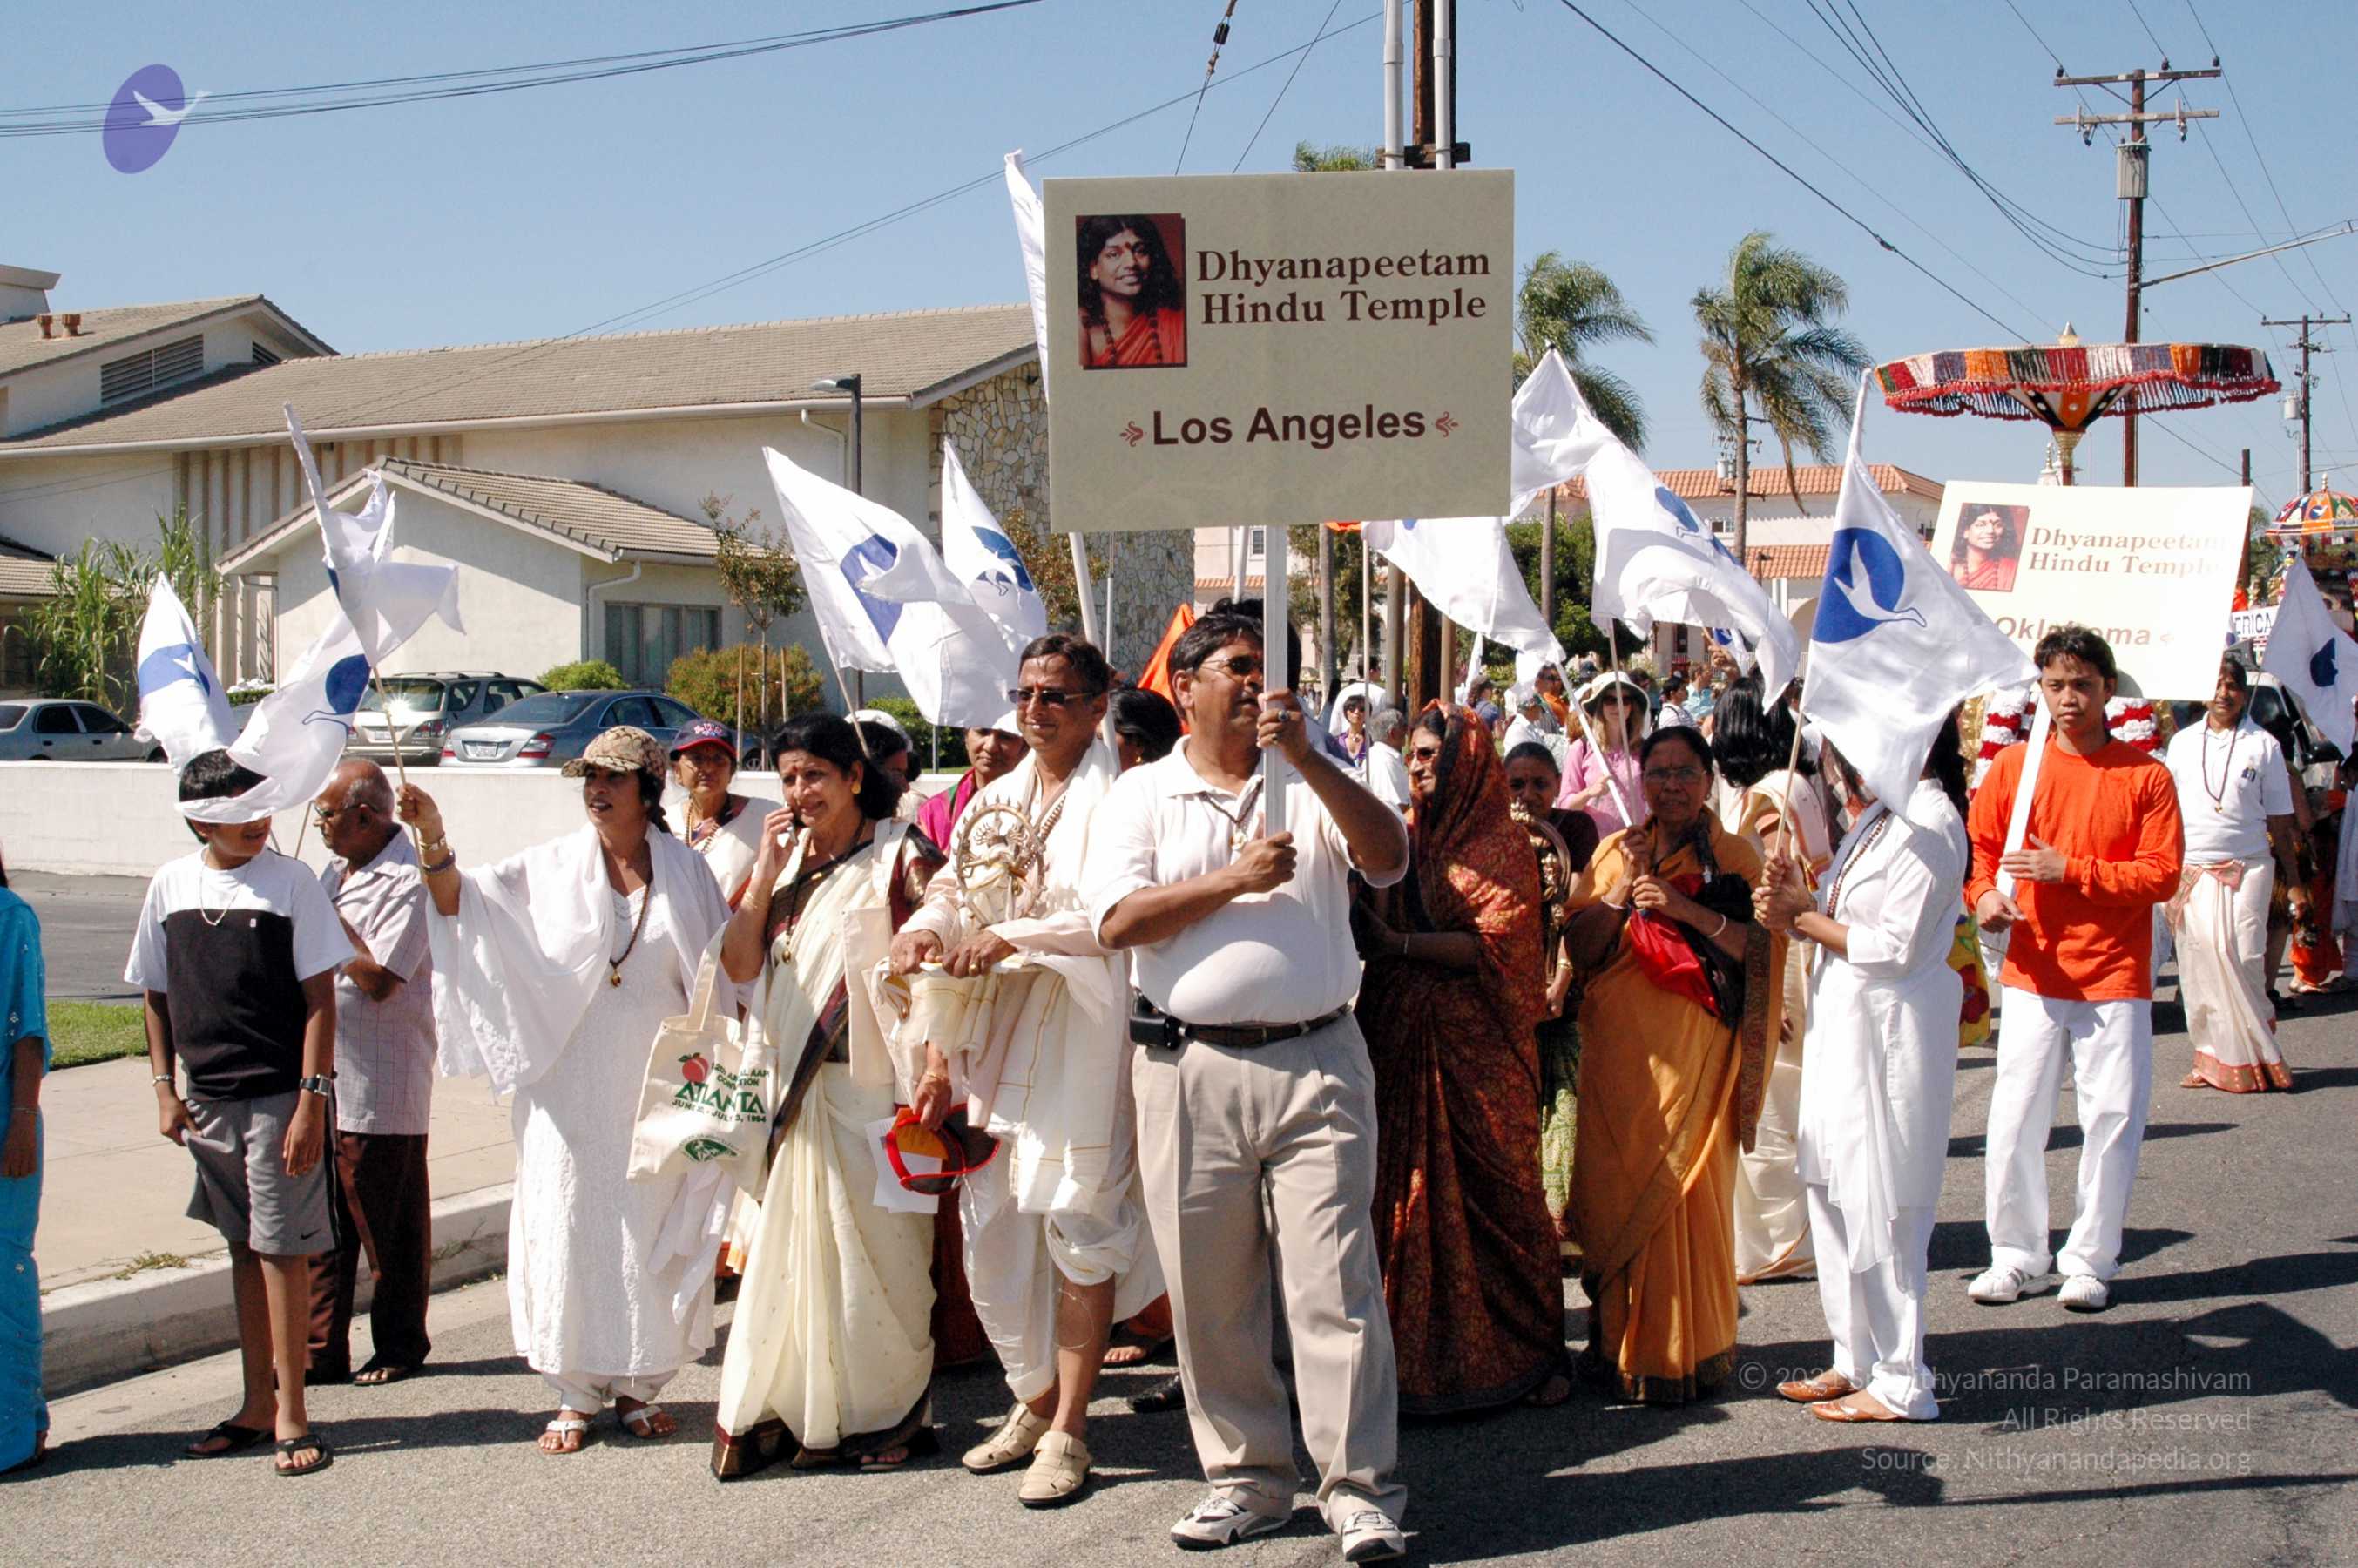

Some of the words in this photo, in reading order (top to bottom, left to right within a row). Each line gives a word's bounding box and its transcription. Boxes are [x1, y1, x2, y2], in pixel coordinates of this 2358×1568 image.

[1196, 249, 1490, 287] Dhyanapeetam
[1201, 292, 1325, 324] Hindu
[1341, 289, 1487, 326] Temple
[1152, 411, 1232, 446] Los
[1246, 404, 1426, 449] Angeles
[2029, 551, 2109, 573] Hindu
[2234, 612, 2273, 634] ERICA
[675, 1081, 767, 1114] ATLANTA
